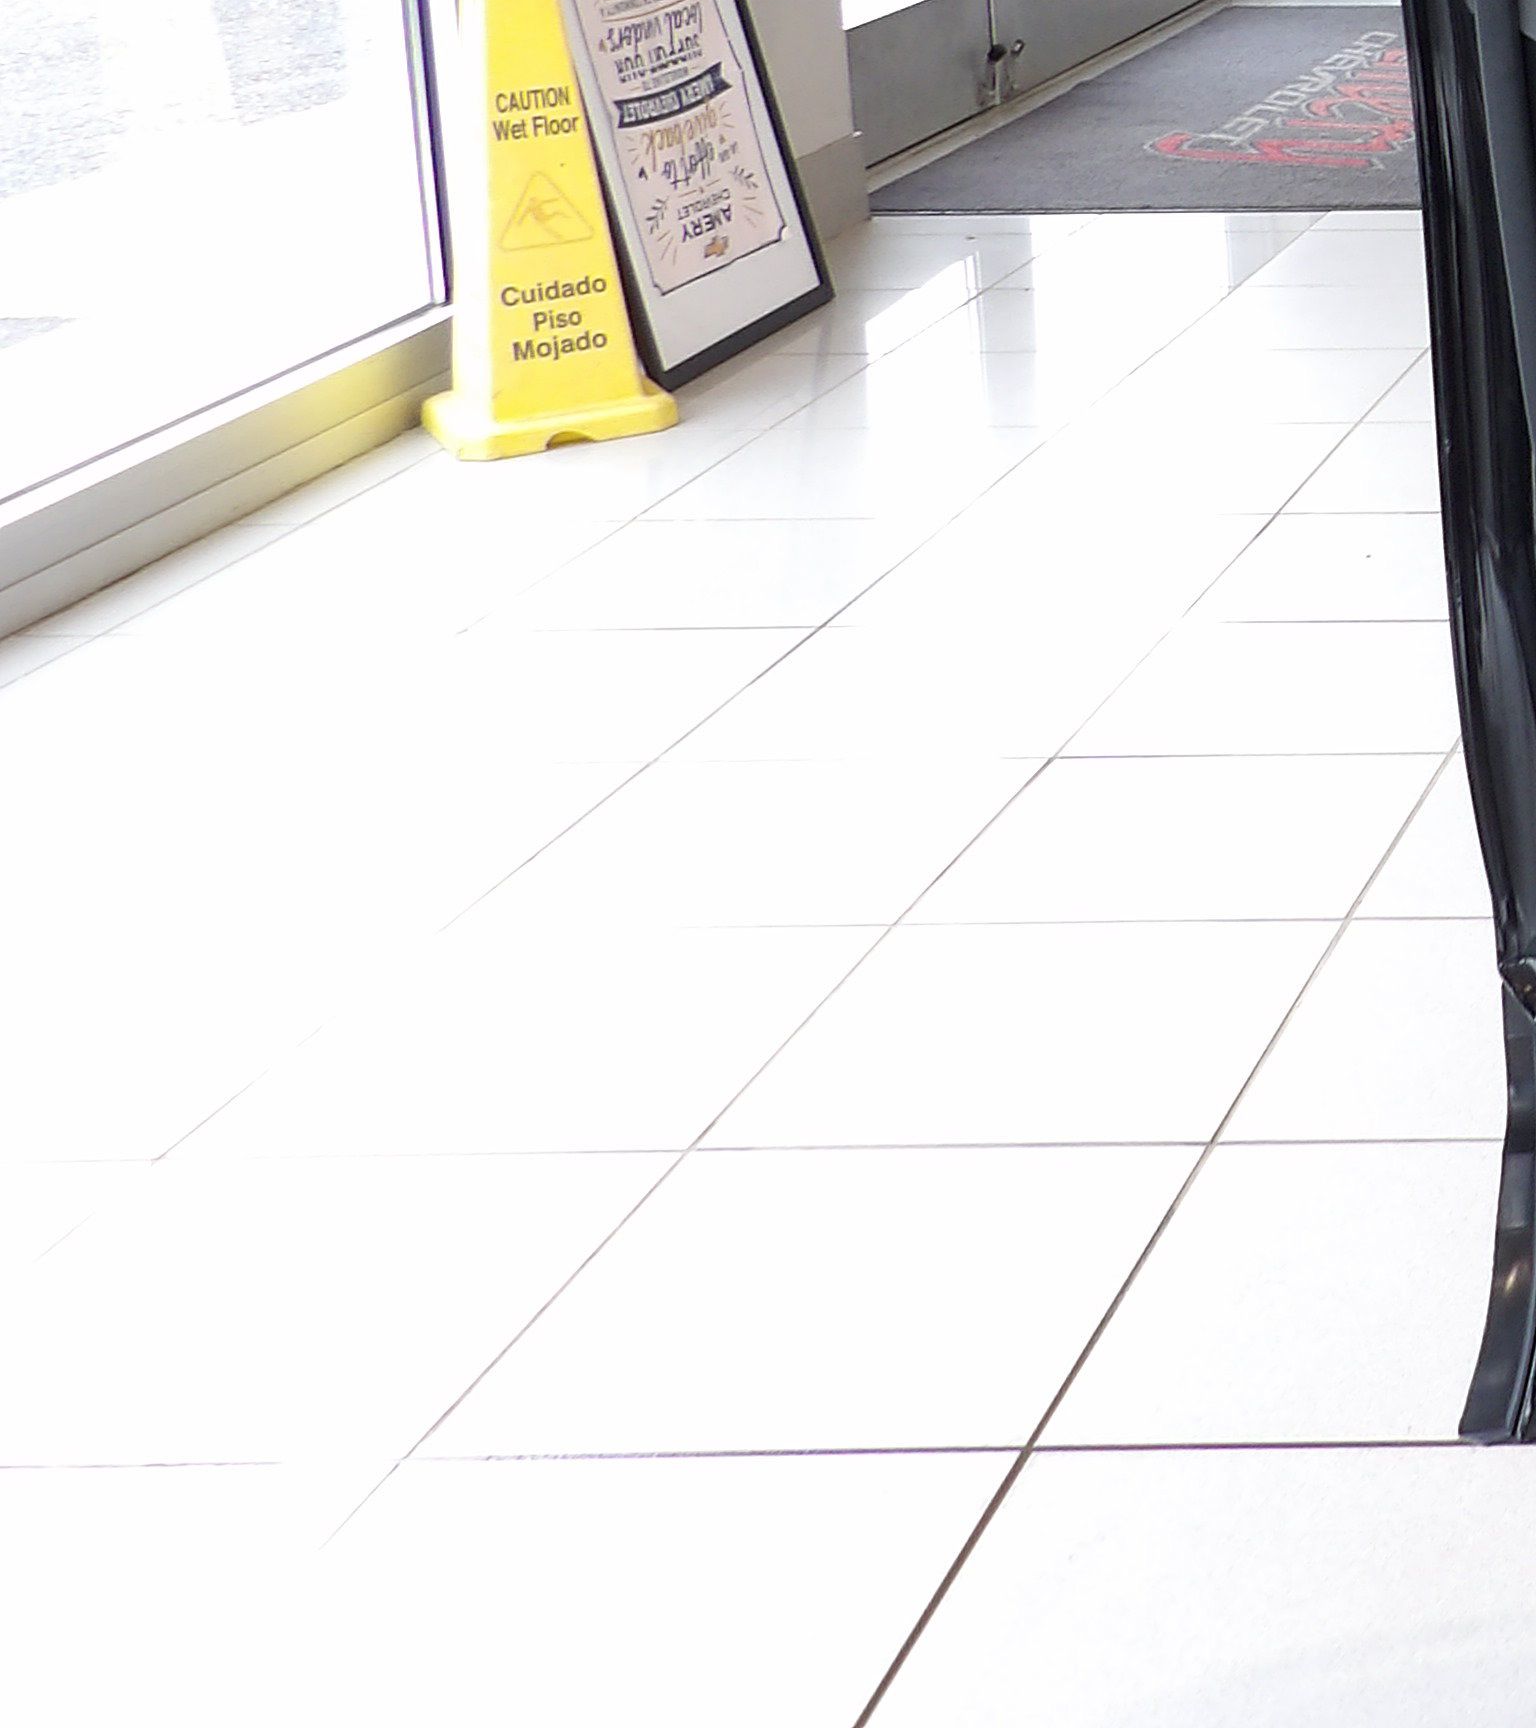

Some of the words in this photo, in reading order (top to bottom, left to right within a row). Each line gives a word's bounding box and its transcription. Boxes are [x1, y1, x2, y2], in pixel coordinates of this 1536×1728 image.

[495, 86, 570, 113] CAUTION
[1199, 31, 1398, 145] CHEVROLET
[492, 119, 528, 141] Wet
[532, 116, 579, 139] Floor
[501, 276, 607, 307] Cuidado
[533, 309, 582, 332] Piso
[513, 331, 608, 361] Mojado
